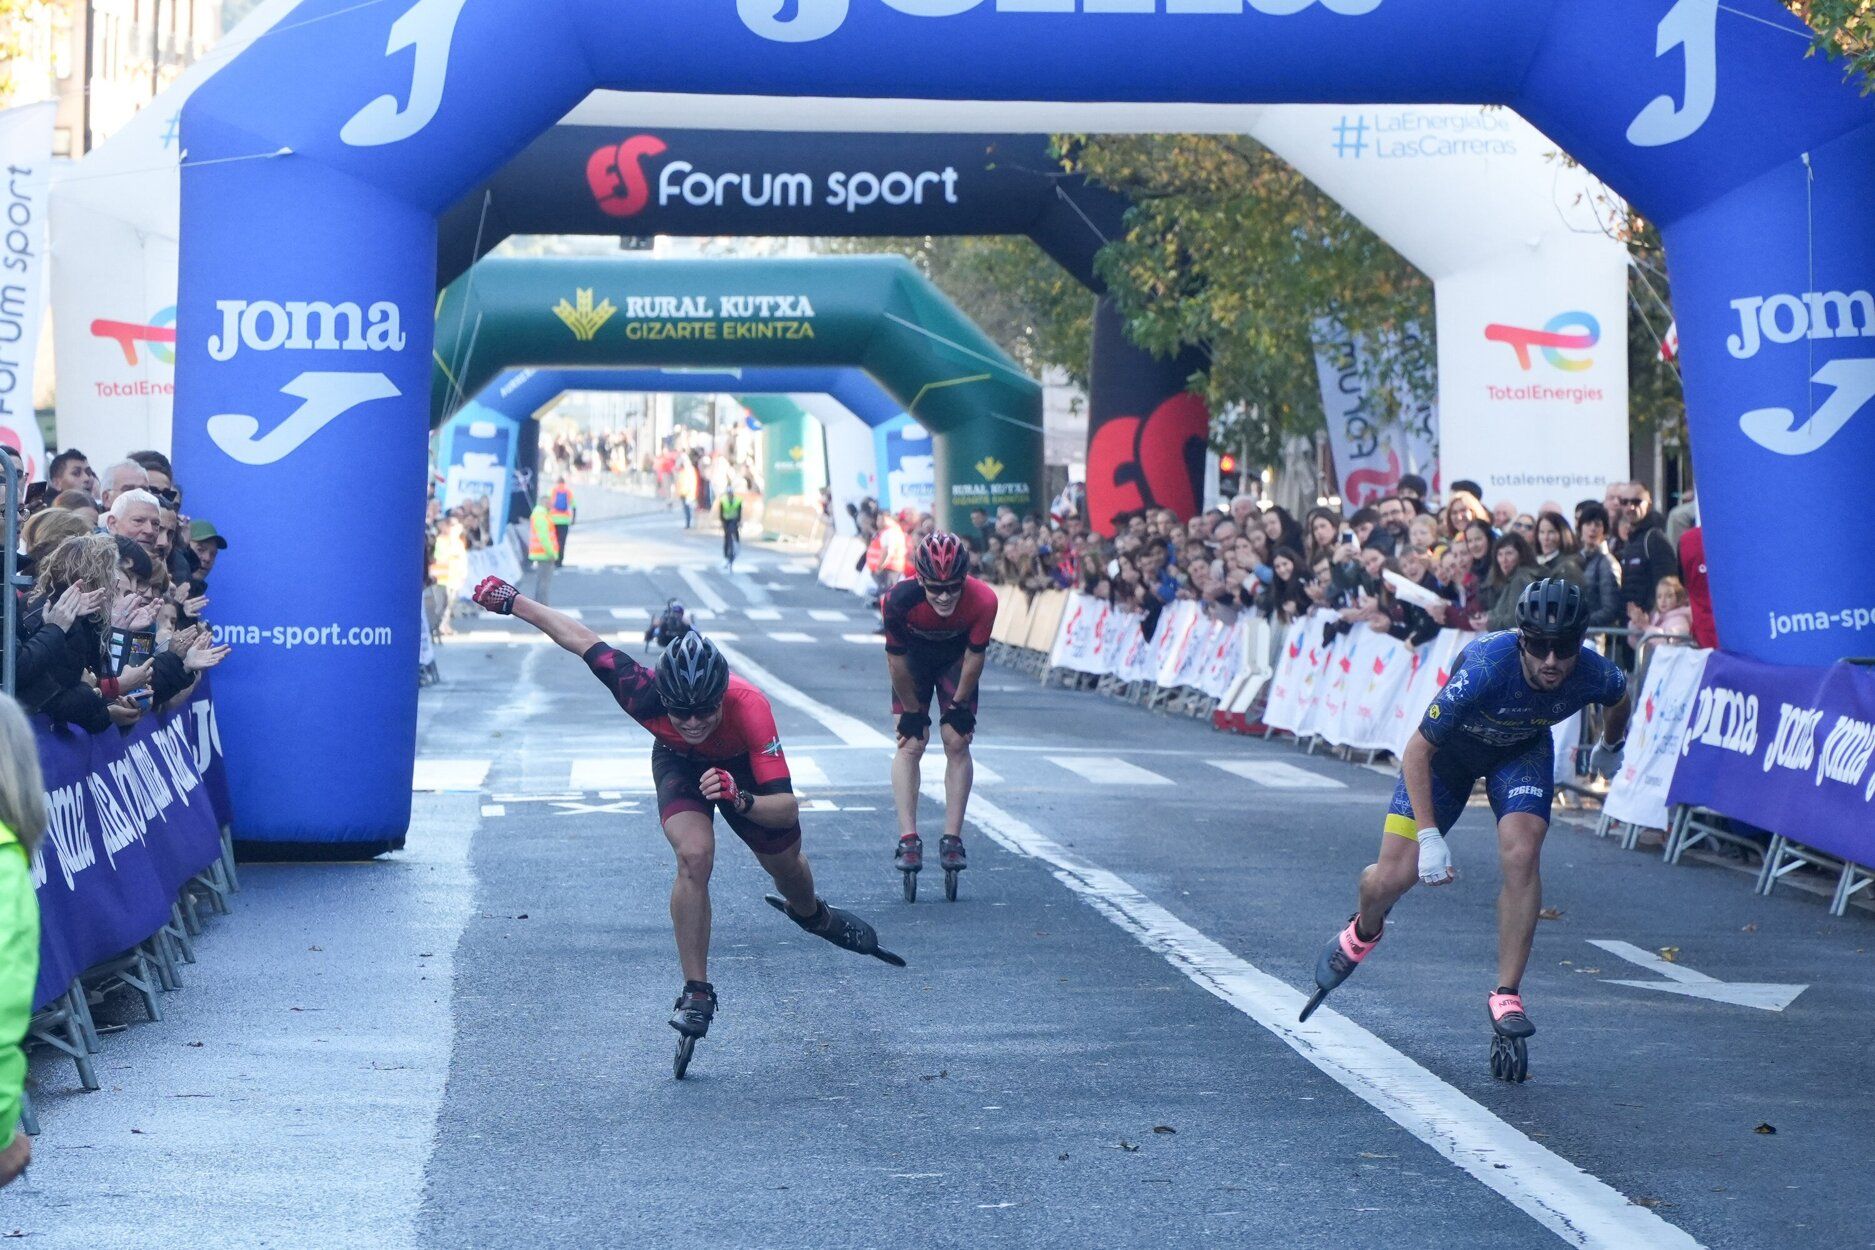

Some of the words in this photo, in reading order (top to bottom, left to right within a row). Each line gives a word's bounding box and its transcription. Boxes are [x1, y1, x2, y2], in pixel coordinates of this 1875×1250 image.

[826, 166, 958, 213] sport
[626, 296, 714, 318] RURAL
[719, 295, 815, 318] KUTXA
[626, 322, 717, 340] GIZARTE
[723, 321, 815, 340] EKINTZA
[1486, 384, 1604, 405] TotalEnergies
[206, 622, 392, 650] oma-sport.com
[1508, 785, 1544, 799] 226ERS
